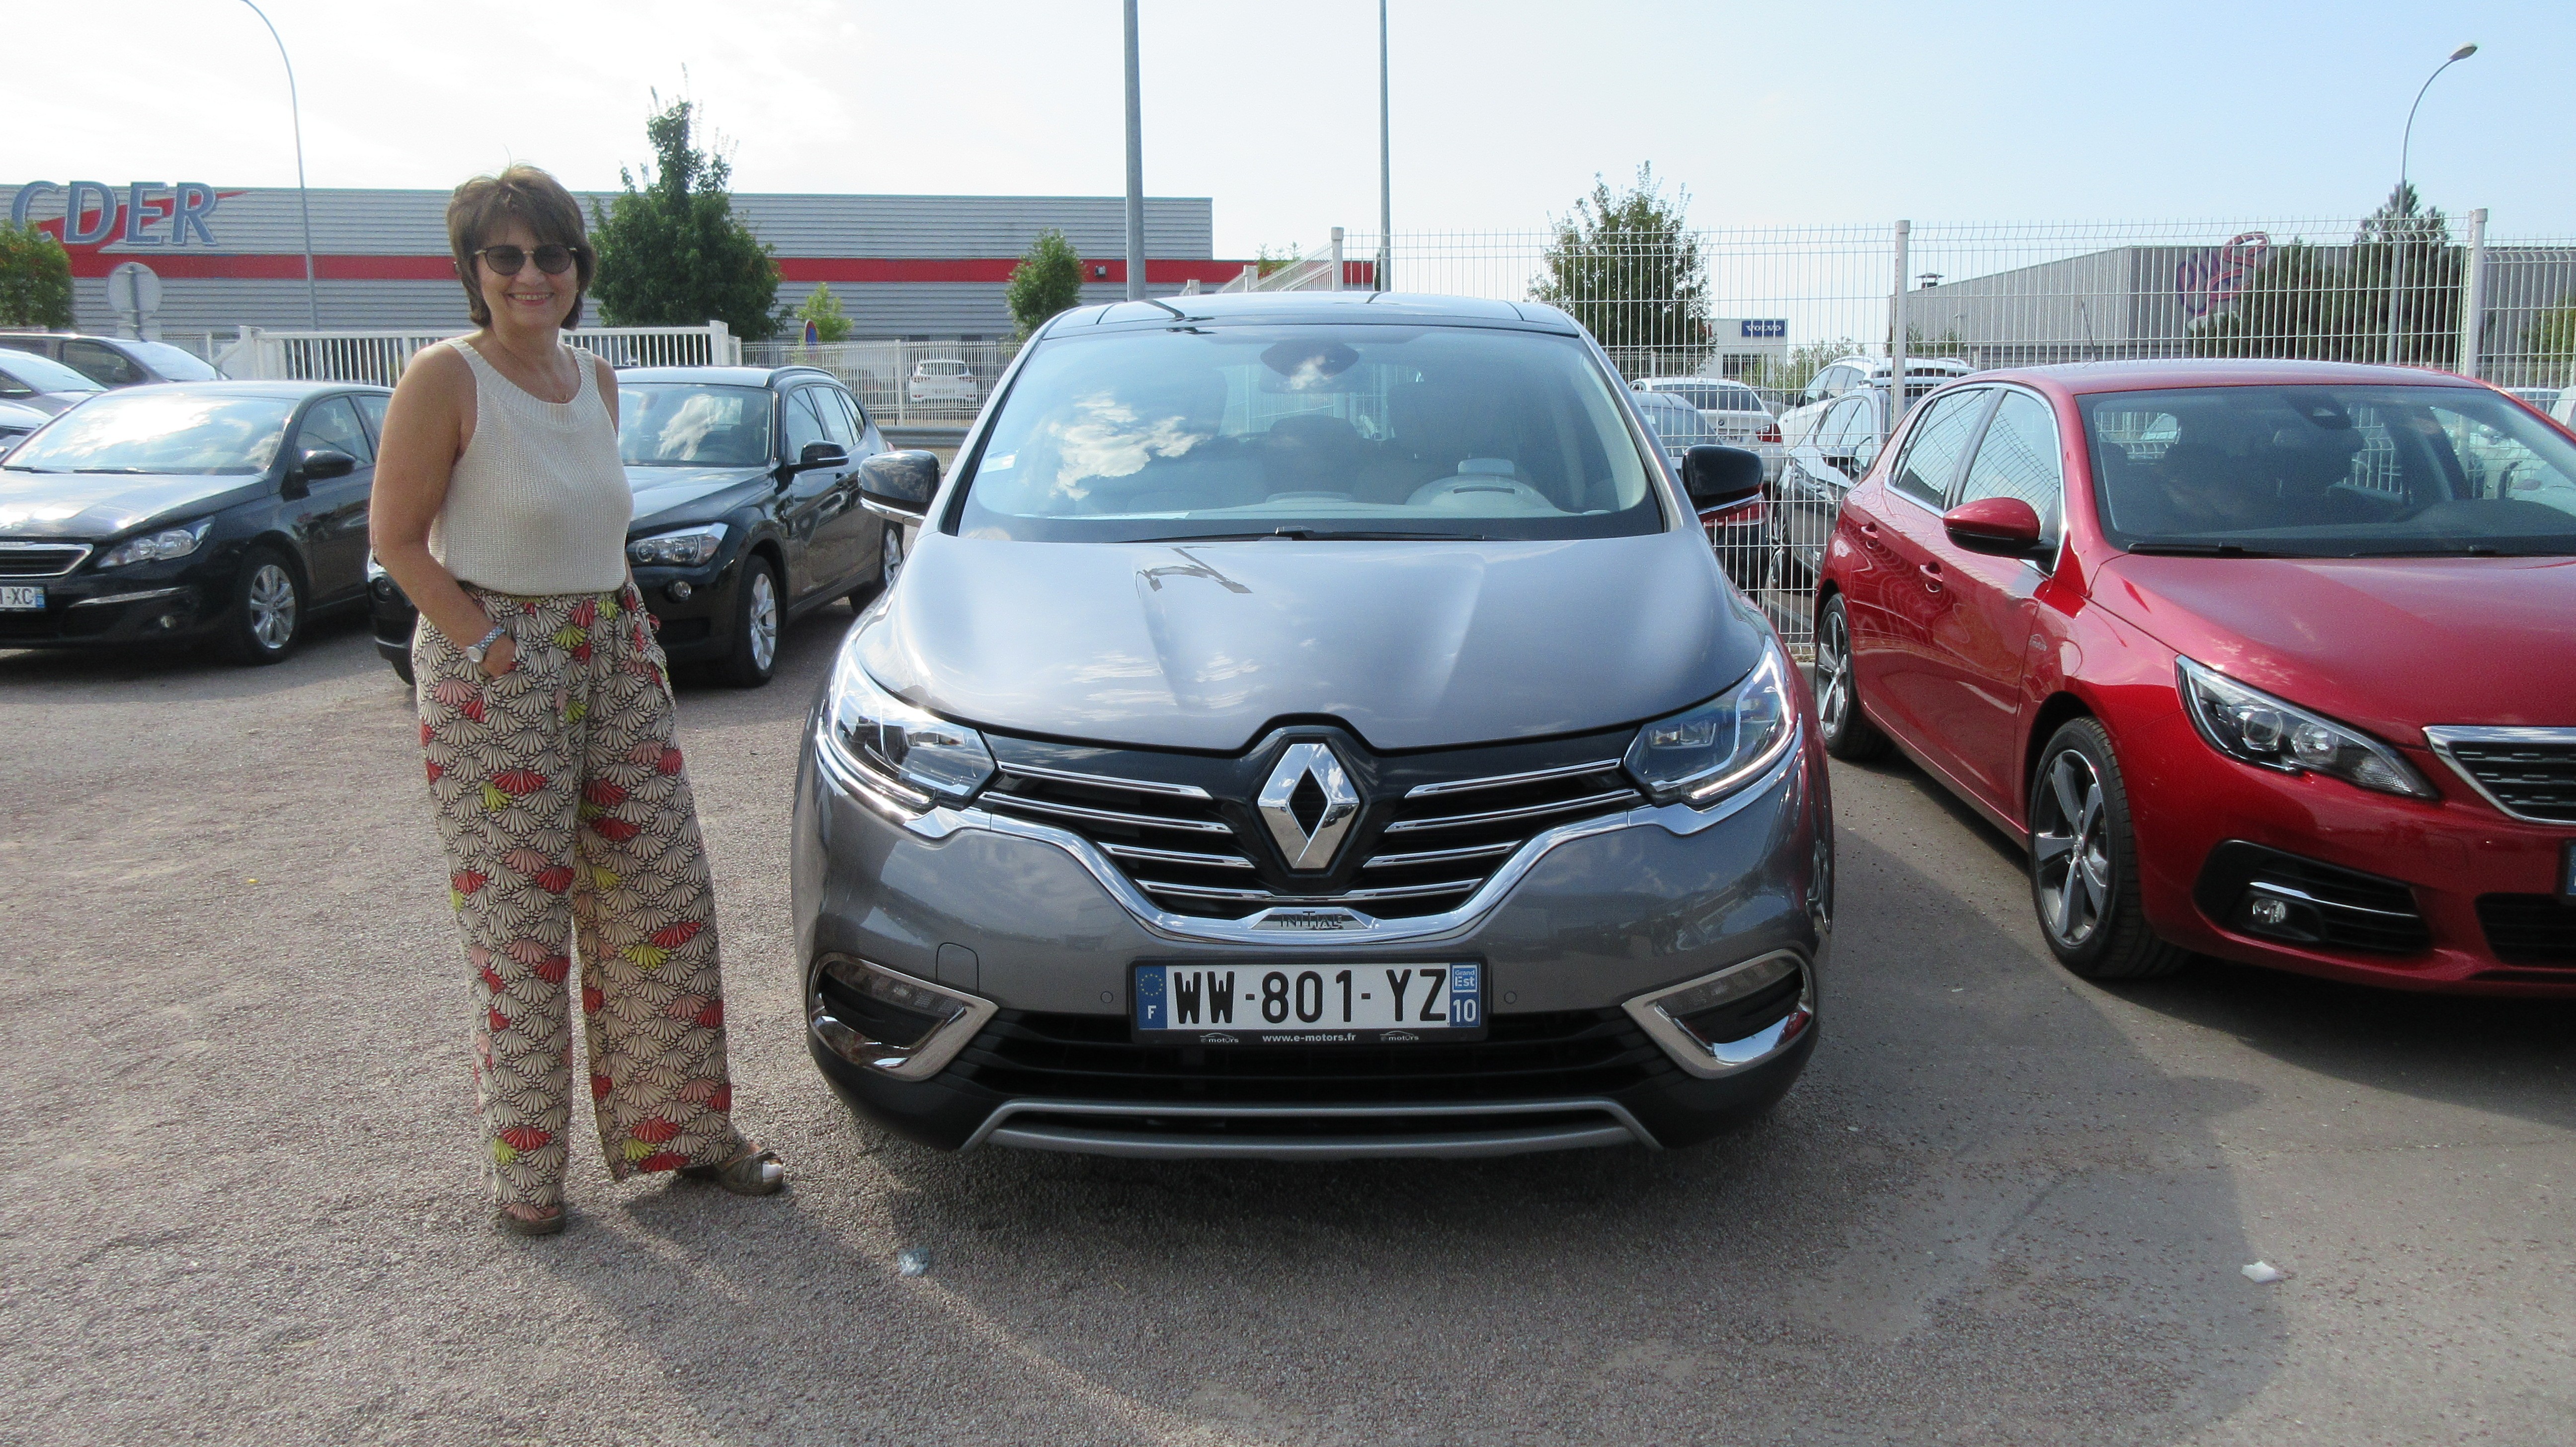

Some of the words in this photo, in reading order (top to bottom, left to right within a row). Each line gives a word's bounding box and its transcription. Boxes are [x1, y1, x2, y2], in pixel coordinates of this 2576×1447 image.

[11, 180, 218, 245] CDER
[1455, 976, 1475, 987] Est
[1147, 1005, 1157, 1019] F
[1453, 999, 1476, 1022] 10
[1262, 1032, 1357, 1042] www.e-motors.fr
